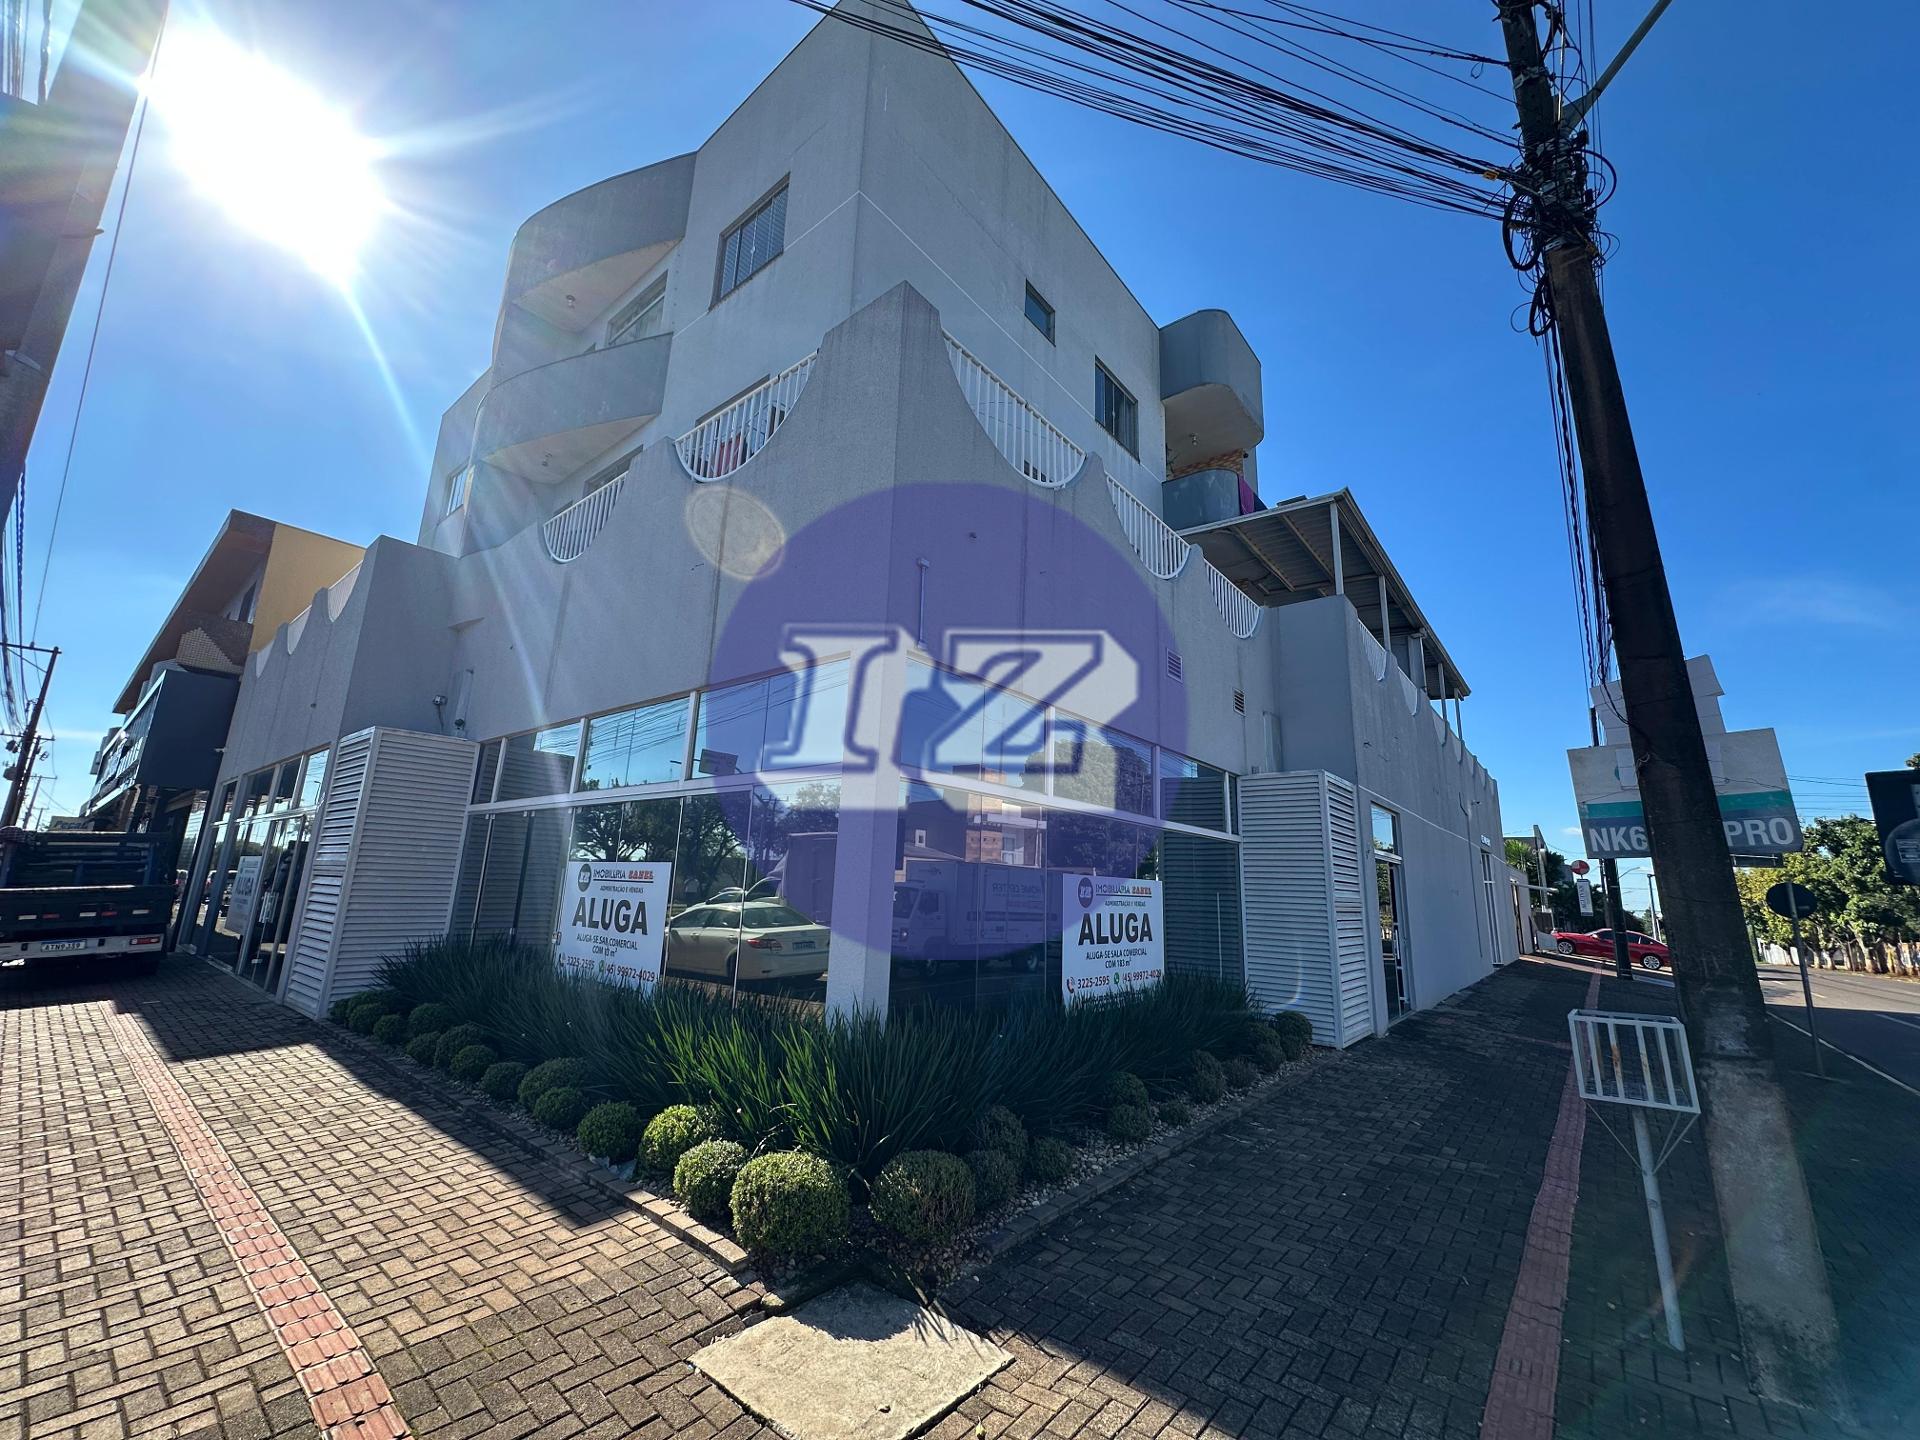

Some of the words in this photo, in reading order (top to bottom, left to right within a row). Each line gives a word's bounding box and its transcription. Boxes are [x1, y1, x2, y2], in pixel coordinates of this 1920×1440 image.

[1588, 826, 1649, 851] NK6
[1724, 817, 1795, 846] PRO
[572, 897, 648, 936] ALUGA
[1078, 912, 1153, 946] ALUGA
[609, 937, 638, 950] COMERCIAL
[1123, 948, 1147, 957] COMERCIAL
[1077, 975, 1110, 989] 3225-2595
